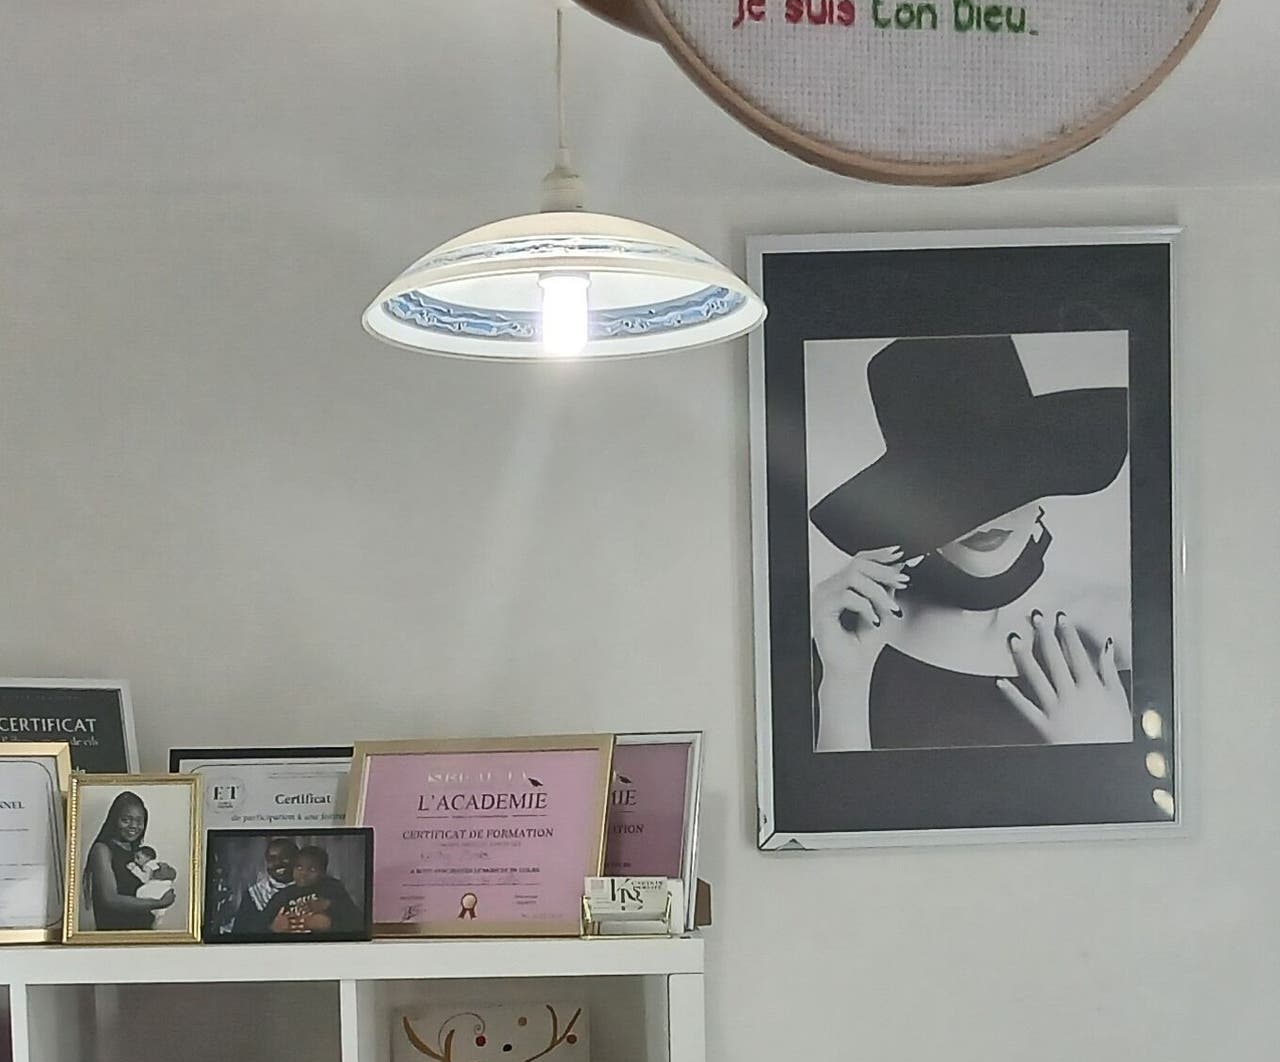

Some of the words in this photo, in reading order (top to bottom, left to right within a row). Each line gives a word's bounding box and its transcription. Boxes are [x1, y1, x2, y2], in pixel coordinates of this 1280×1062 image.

[873, 0, 937, 30] ton
[213, 786, 239, 801] ET
[274, 793, 331, 805] Certificat
[418, 792, 548, 811] L'ACADEMIE
[402, 829, 467, 841] CERTIFICAT
[469, 829, 484, 840] DE
[486, 828, 554, 840] FORMATION
